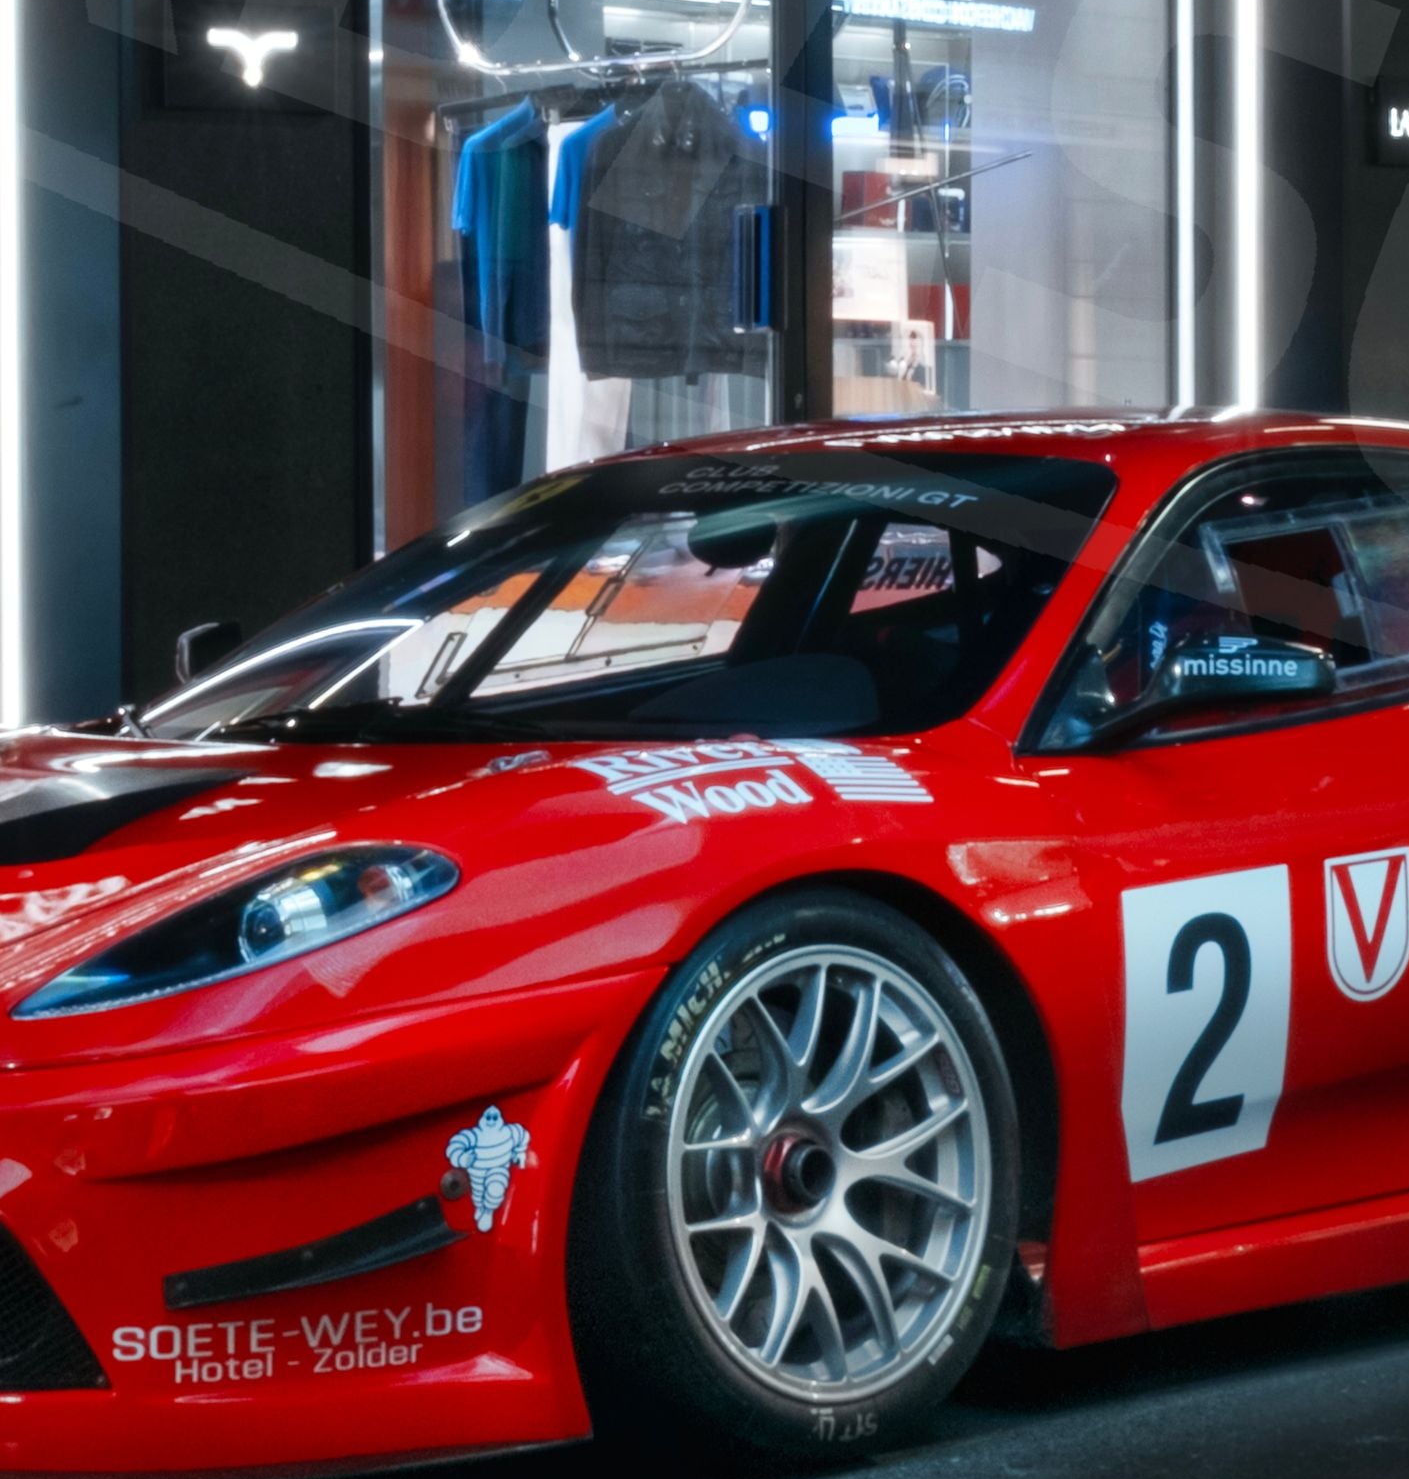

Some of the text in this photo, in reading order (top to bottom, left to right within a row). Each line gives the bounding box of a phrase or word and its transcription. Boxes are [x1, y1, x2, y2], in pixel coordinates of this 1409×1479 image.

[656, 478, 980, 510] COMPETIZIONI GT
[684, 463, 779, 481] CLUB
[1183, 652, 1298, 677] missinne
[631, 769, 814, 825] Wood
[1152, 910, 1253, 1147] 2
[111, 1302, 484, 1362] SOETE-WEY.be
[173, 1348, 274, 1385] Hotel
[313, 1341, 424, 1375] Zolder
